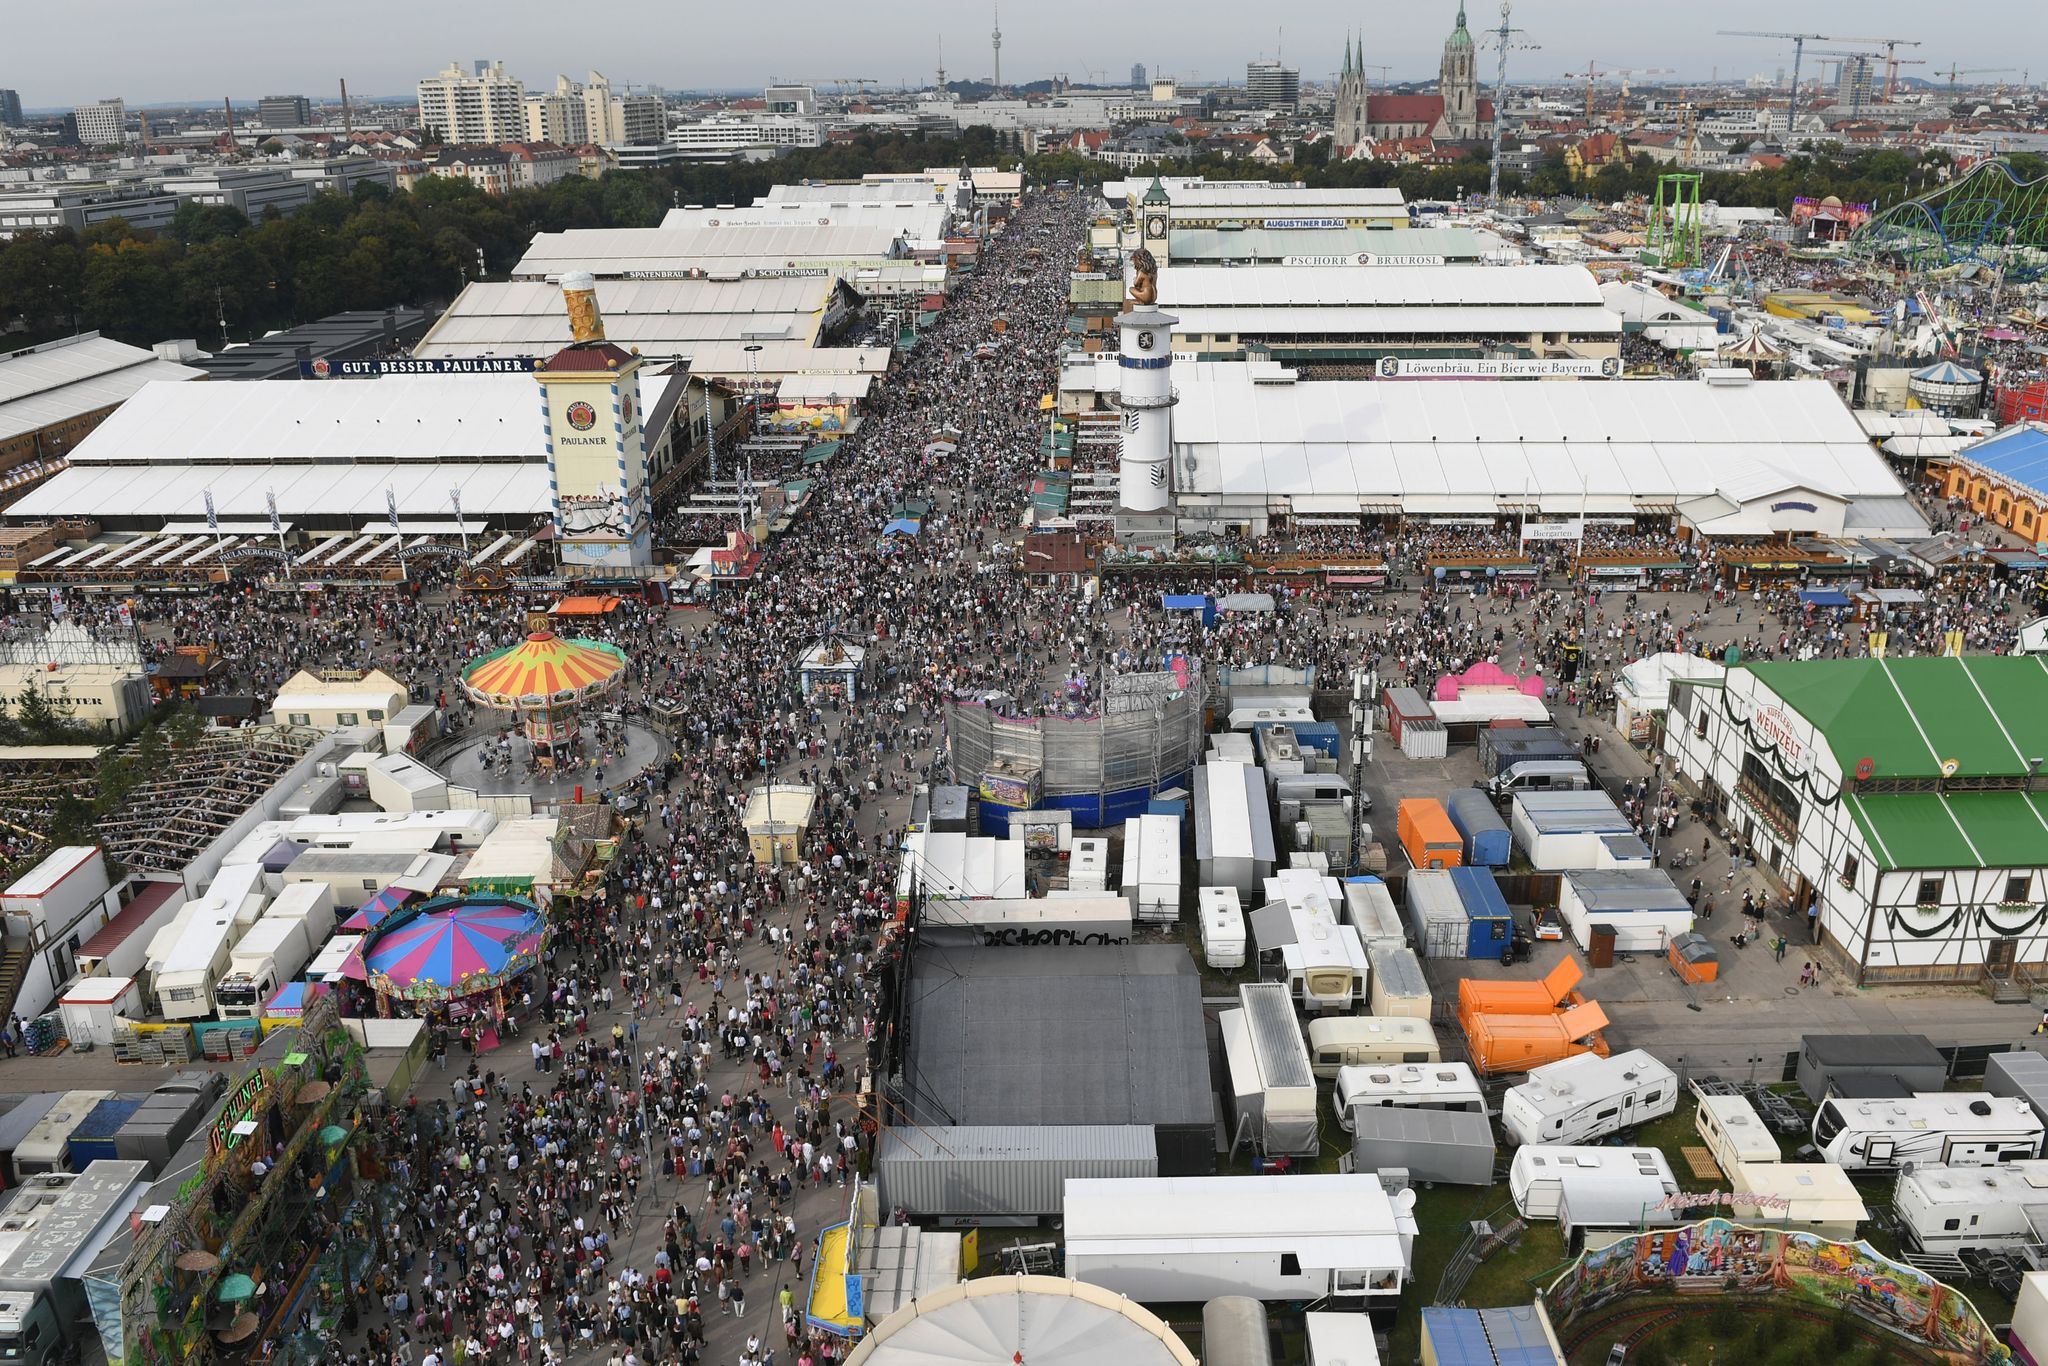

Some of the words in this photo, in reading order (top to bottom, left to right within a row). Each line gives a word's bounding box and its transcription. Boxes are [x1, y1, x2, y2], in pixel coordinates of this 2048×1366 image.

[1321, 218, 1344, 227] BRÄU
[1291, 257, 1347, 265] PSCHORR
[1377, 256, 1439, 265] BRÄUROSL
[759, 268, 827, 276] SCHOTTENHAMEL
[342, 362, 377, 374] GUT,
[380, 361, 440, 373] BESSER,
[443, 360, 528, 373] PAULANER.
[1406, 362, 1473, 374] Löwenbräu.
[1478, 362, 1497, 374] Ein
[1501, 362, 1524, 374] Bier
[1528, 362, 1547, 374] wie
[1551, 362, 1594, 376] Bayern.
[568, 402, 594, 414] PAULANER
[560, 437, 607, 445] PAULANER
[1533, 529, 1572, 538] Biergarten
[218, 547, 290, 562] PAULANERGARTEN
[398, 545, 469, 559] PAULANERGARTEN
[1756, 708, 1802, 760] WEINZELT
[211, 1068, 270, 1154] DSCHUNGEL
[1653, 1188, 1789, 1212] Märchenbahn
